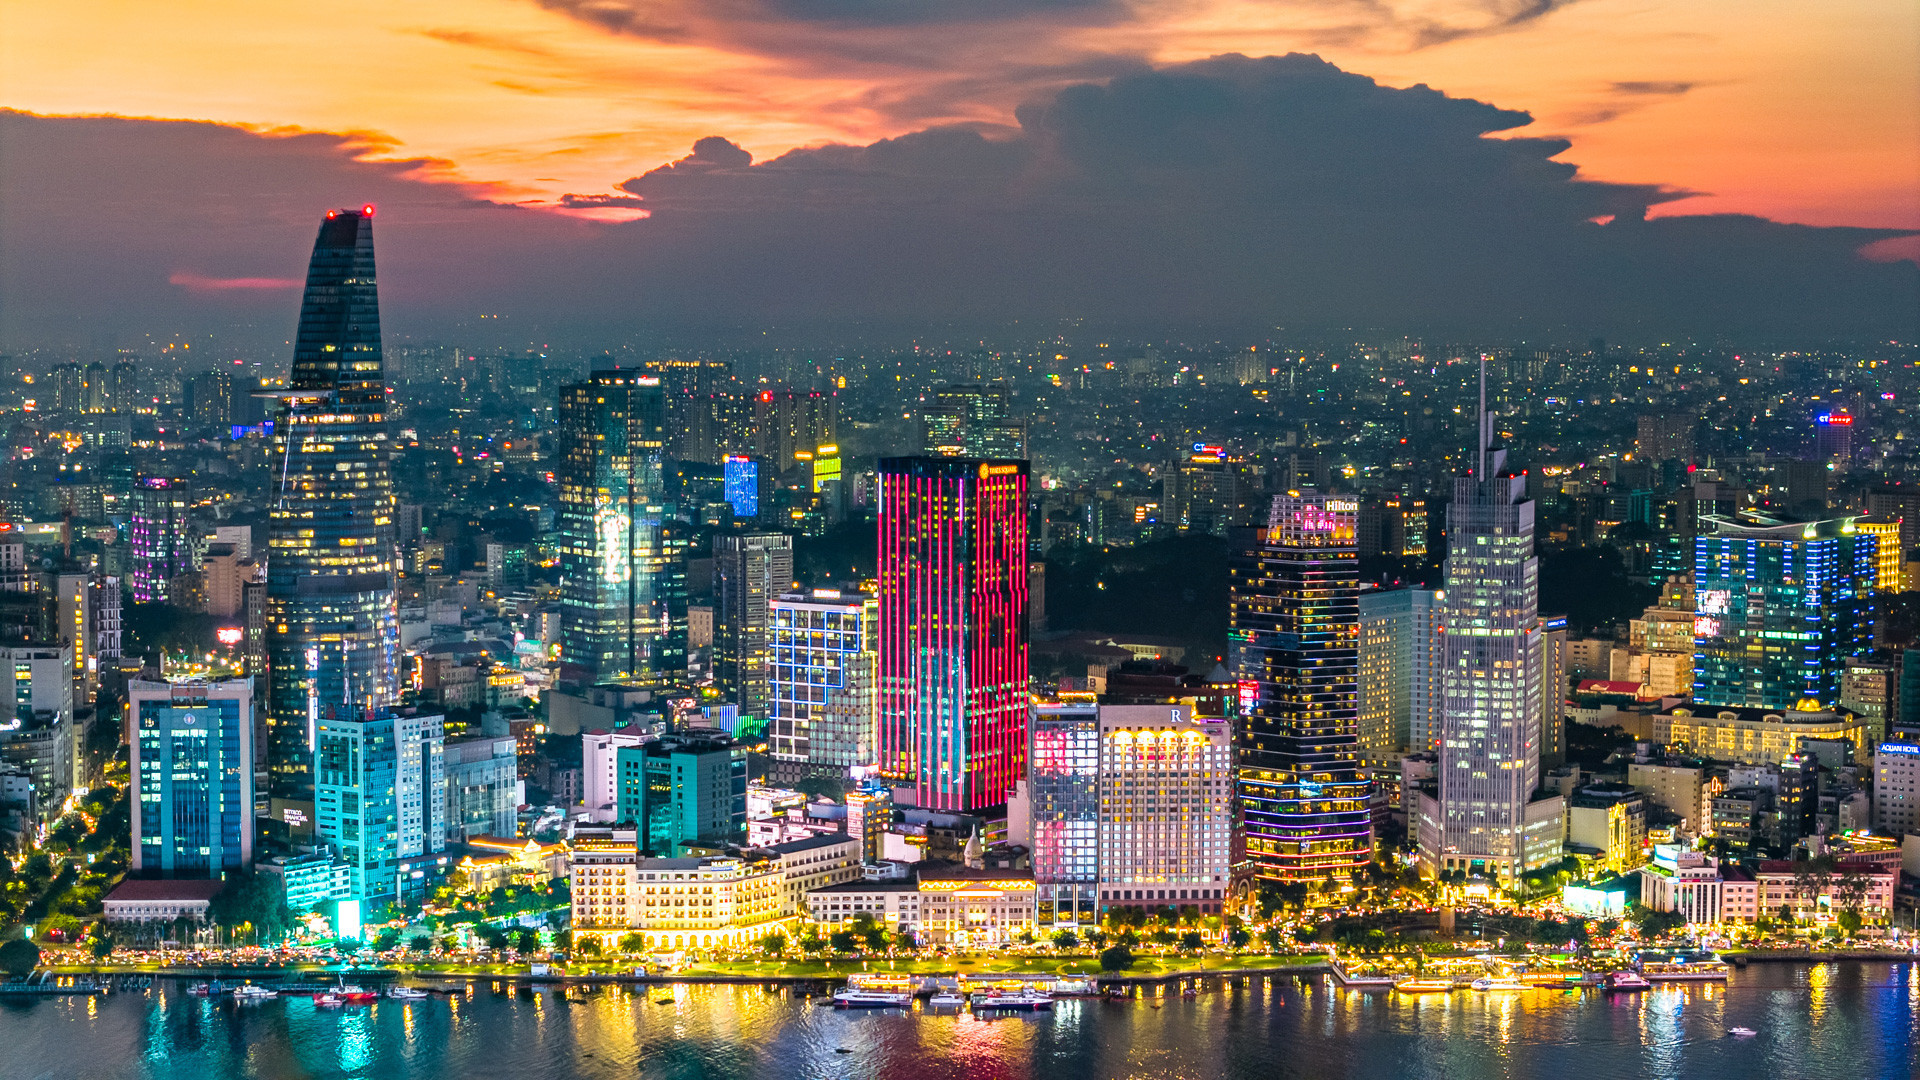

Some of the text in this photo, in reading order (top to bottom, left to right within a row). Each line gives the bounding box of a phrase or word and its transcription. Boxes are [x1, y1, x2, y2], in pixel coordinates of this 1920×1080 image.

[1326, 500, 1358, 511] Hilton
[1089, 678, 1096, 686] B
[1171, 709, 1183, 722] R
[1903, 746, 1920, 754] HOTEL
